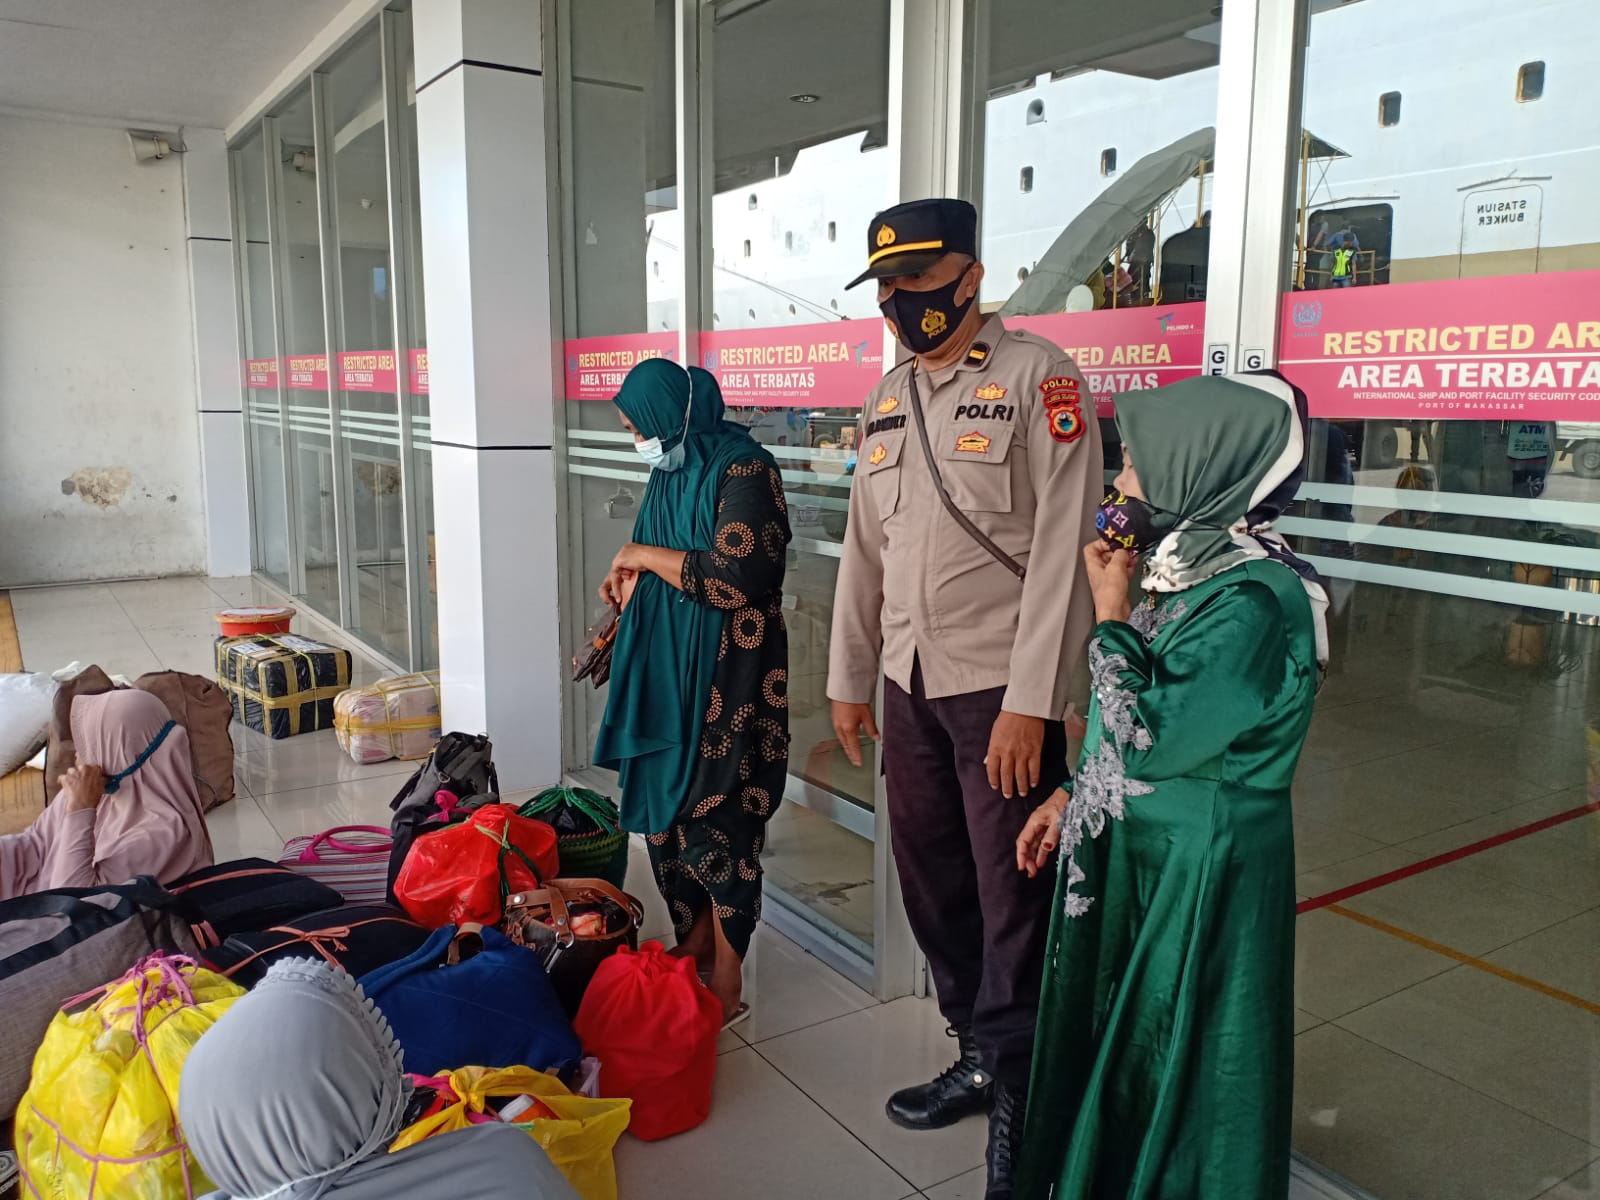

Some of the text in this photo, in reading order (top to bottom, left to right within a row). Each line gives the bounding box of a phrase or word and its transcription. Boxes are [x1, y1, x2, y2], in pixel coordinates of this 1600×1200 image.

[1323, 321, 1600, 356] RESTRICTED AR
[579, 351, 633, 368] RESTRICTED
[720, 342, 849, 366] RESTRICTED AREA
[1110, 343, 1172, 365] AREA
[343, 355, 395, 370] RESTRICTED AREA
[580, 372, 600, 385] AREA
[721, 372, 815, 388] AREA TERBATAS
[1337, 361, 1600, 389] AREA TERBATA
[1042, 379, 1074, 391] POLDA
[1353, 391, 1600, 401] INTERNATIONAL SHIP AND PORT FACILITY SECURITY COD
[954, 404, 1014, 421] POLRI
[1519, 425, 1546, 434] ATM
